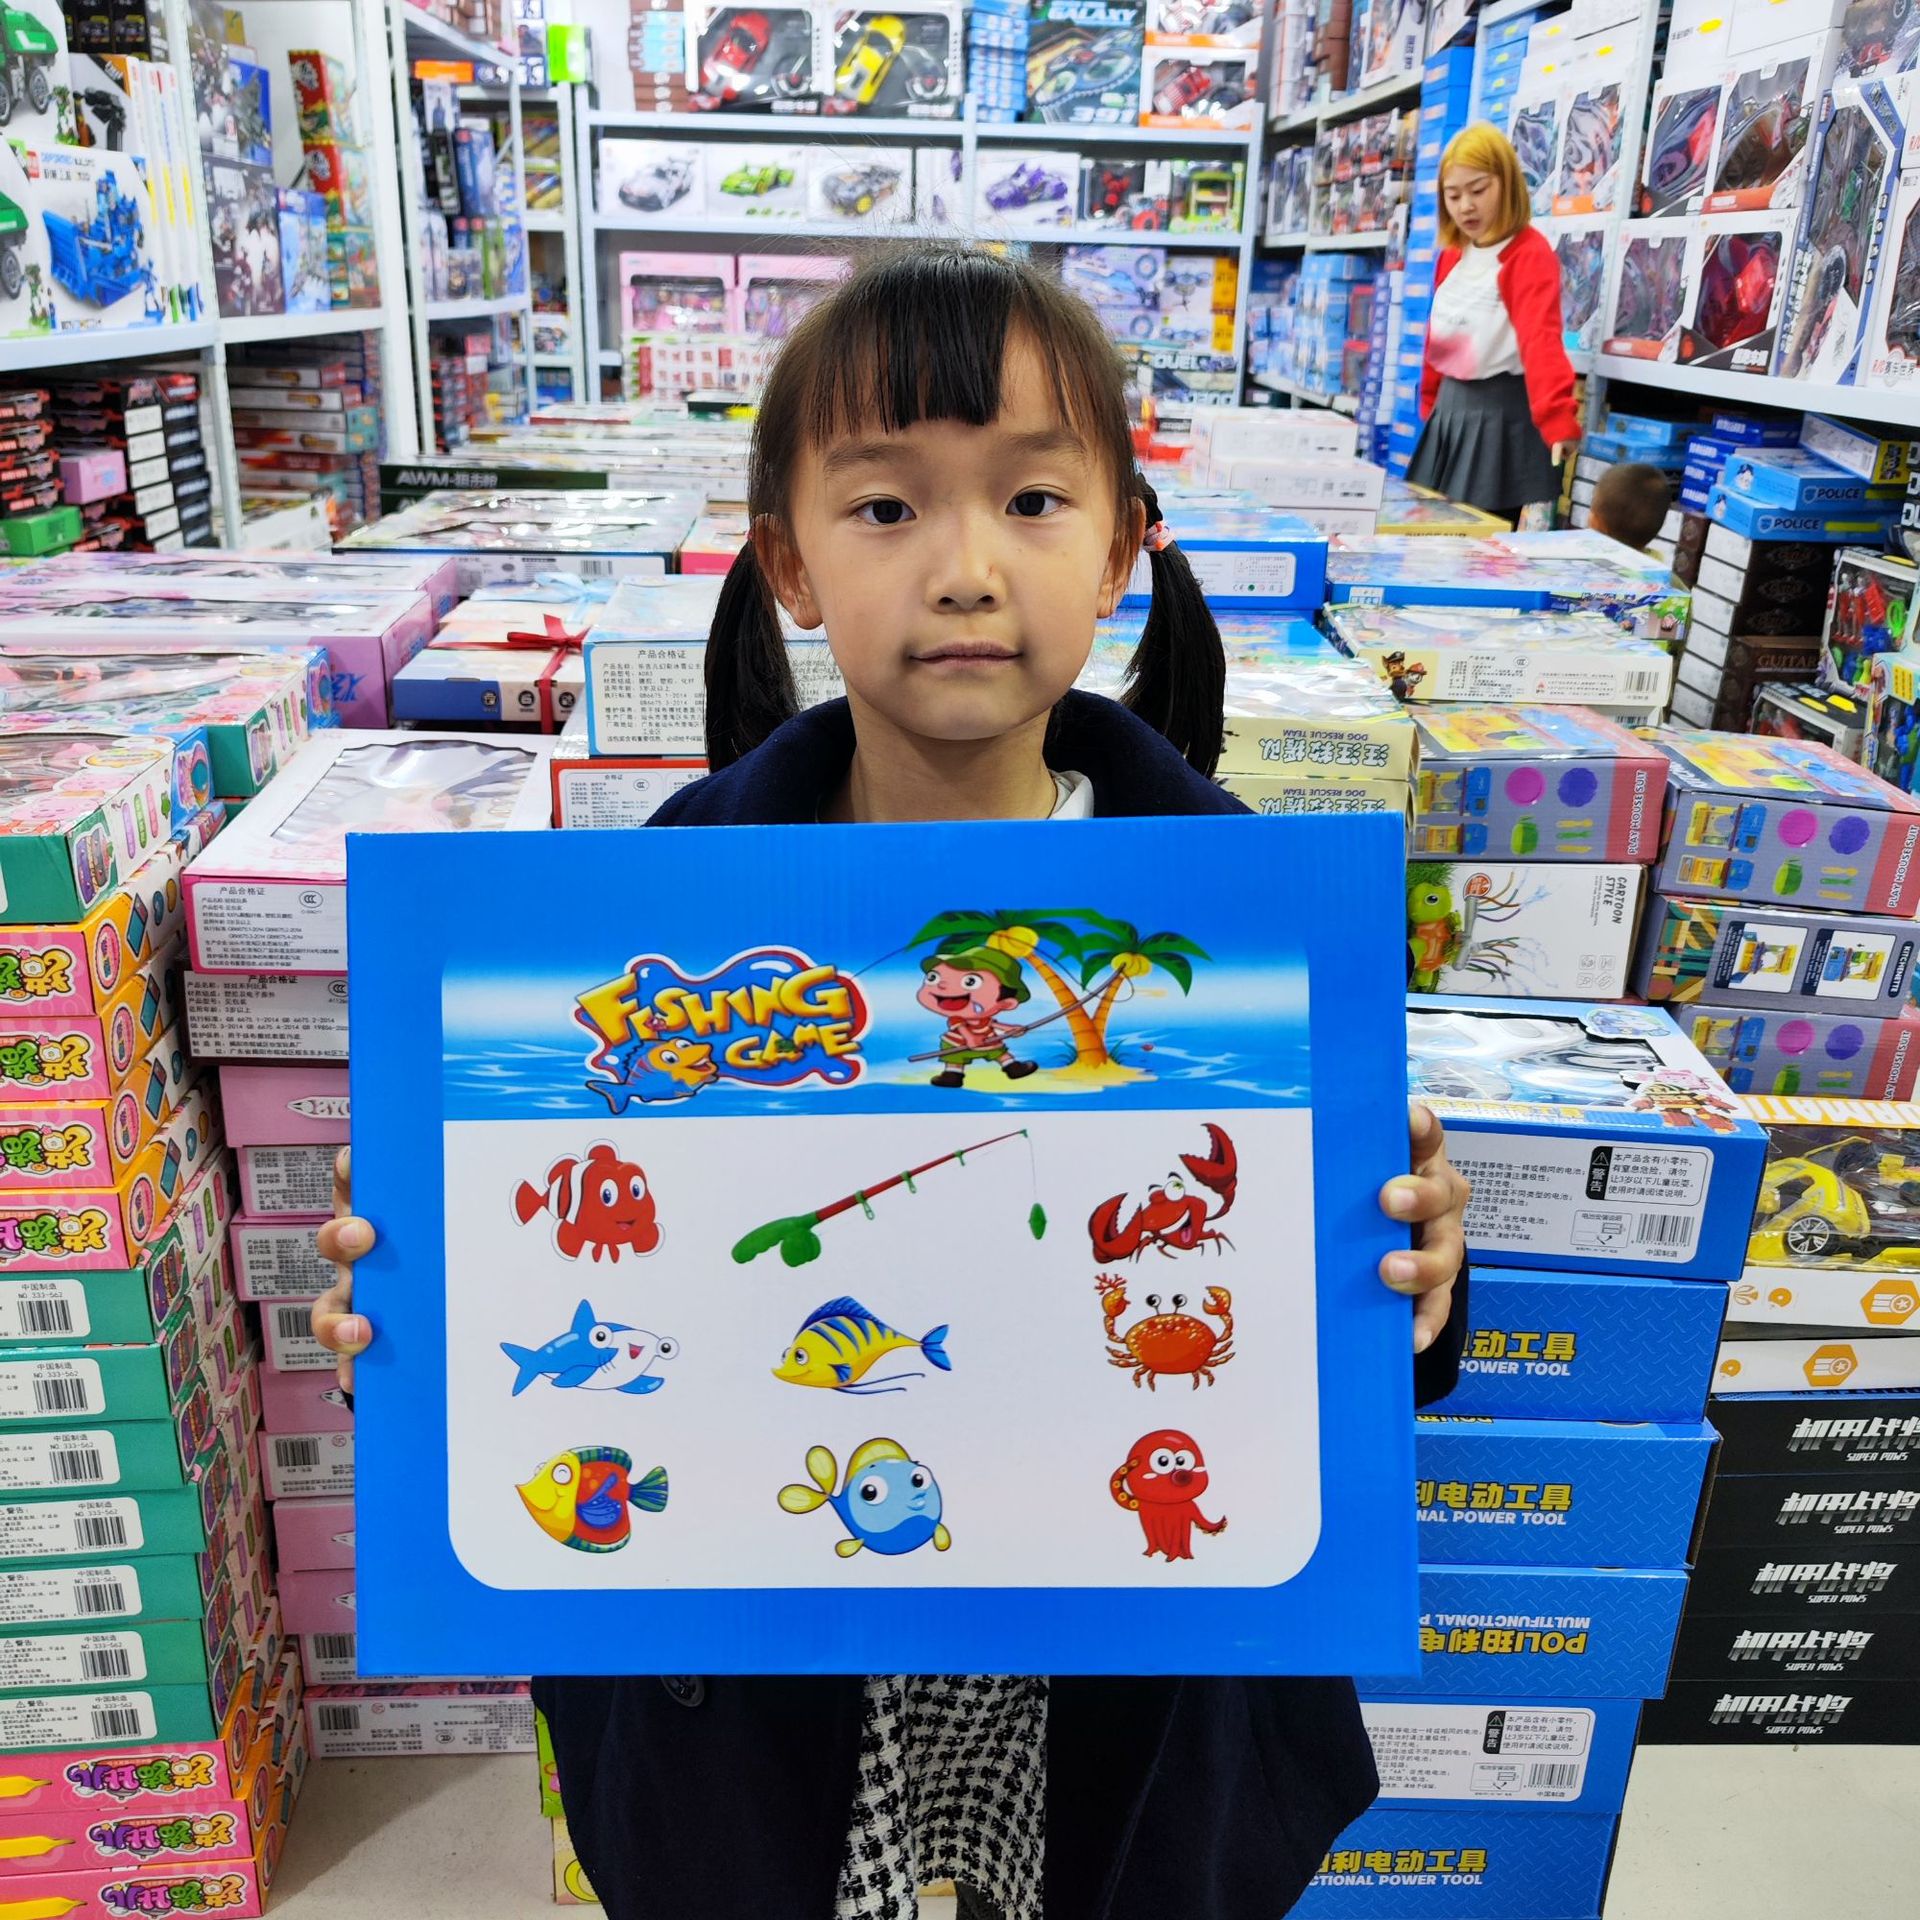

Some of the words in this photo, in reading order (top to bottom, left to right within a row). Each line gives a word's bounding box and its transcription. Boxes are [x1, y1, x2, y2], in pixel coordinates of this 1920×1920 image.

[1818, 488, 1859, 499] POLICE
[1774, 518, 1820, 530] POLICE
[638, 650, 686, 659] 产品合格证
[1283, 729, 1307, 738] TEAM
[1309, 731, 1344, 739] RESCUE
[1347, 733, 1368, 742] DOG
[1258, 738, 1390, 767] 汪汪救援队
[1635, 769, 1647, 793] SUIT
[1283, 788, 1306, 796] TEAM
[1309, 789, 1342, 797] RESCUE
[1345, 789, 1366, 797] DOG
[1631, 793, 1645, 832] HOUSE
[1627, 830, 1640, 856] PLAY
[1904, 825, 1920, 847] SUIT
[1896, 845, 1913, 886] HOUSE
[220, 887, 266, 895] 产品合格证
[1602, 876, 1616, 906] STYLE
[1888, 882, 1902, 908] PLAY
[1611, 876, 1627, 924] CARTOON
[248, 975, 298, 984] 产品合格证
[575, 965, 852, 1047] FISHING
[725, 1021, 861, 1068] GAME
[1883, 1078, 1897, 1100] LAY
[1890, 1050, 1906, 1081] HOUSE
[1899, 1030, 1912, 1052] SUIT
[1588, 1167, 1604, 1193] 警告
[1645, 1249, 1678, 1258] 中国制造
[1462, 1328, 1577, 1362] 动工具
[1525, 1361, 1571, 1376] TOOL
[1452, 1511, 1516, 1524] POWER
[1521, 1512, 1567, 1526] TOOL
[1436, 1614, 1591, 1629] MULTIFUNCTIONAL
[1486, 1729, 1501, 1748] 警告
[1378, 1874, 1440, 1885] POWER
[1442, 1874, 1483, 1885] TOOL
